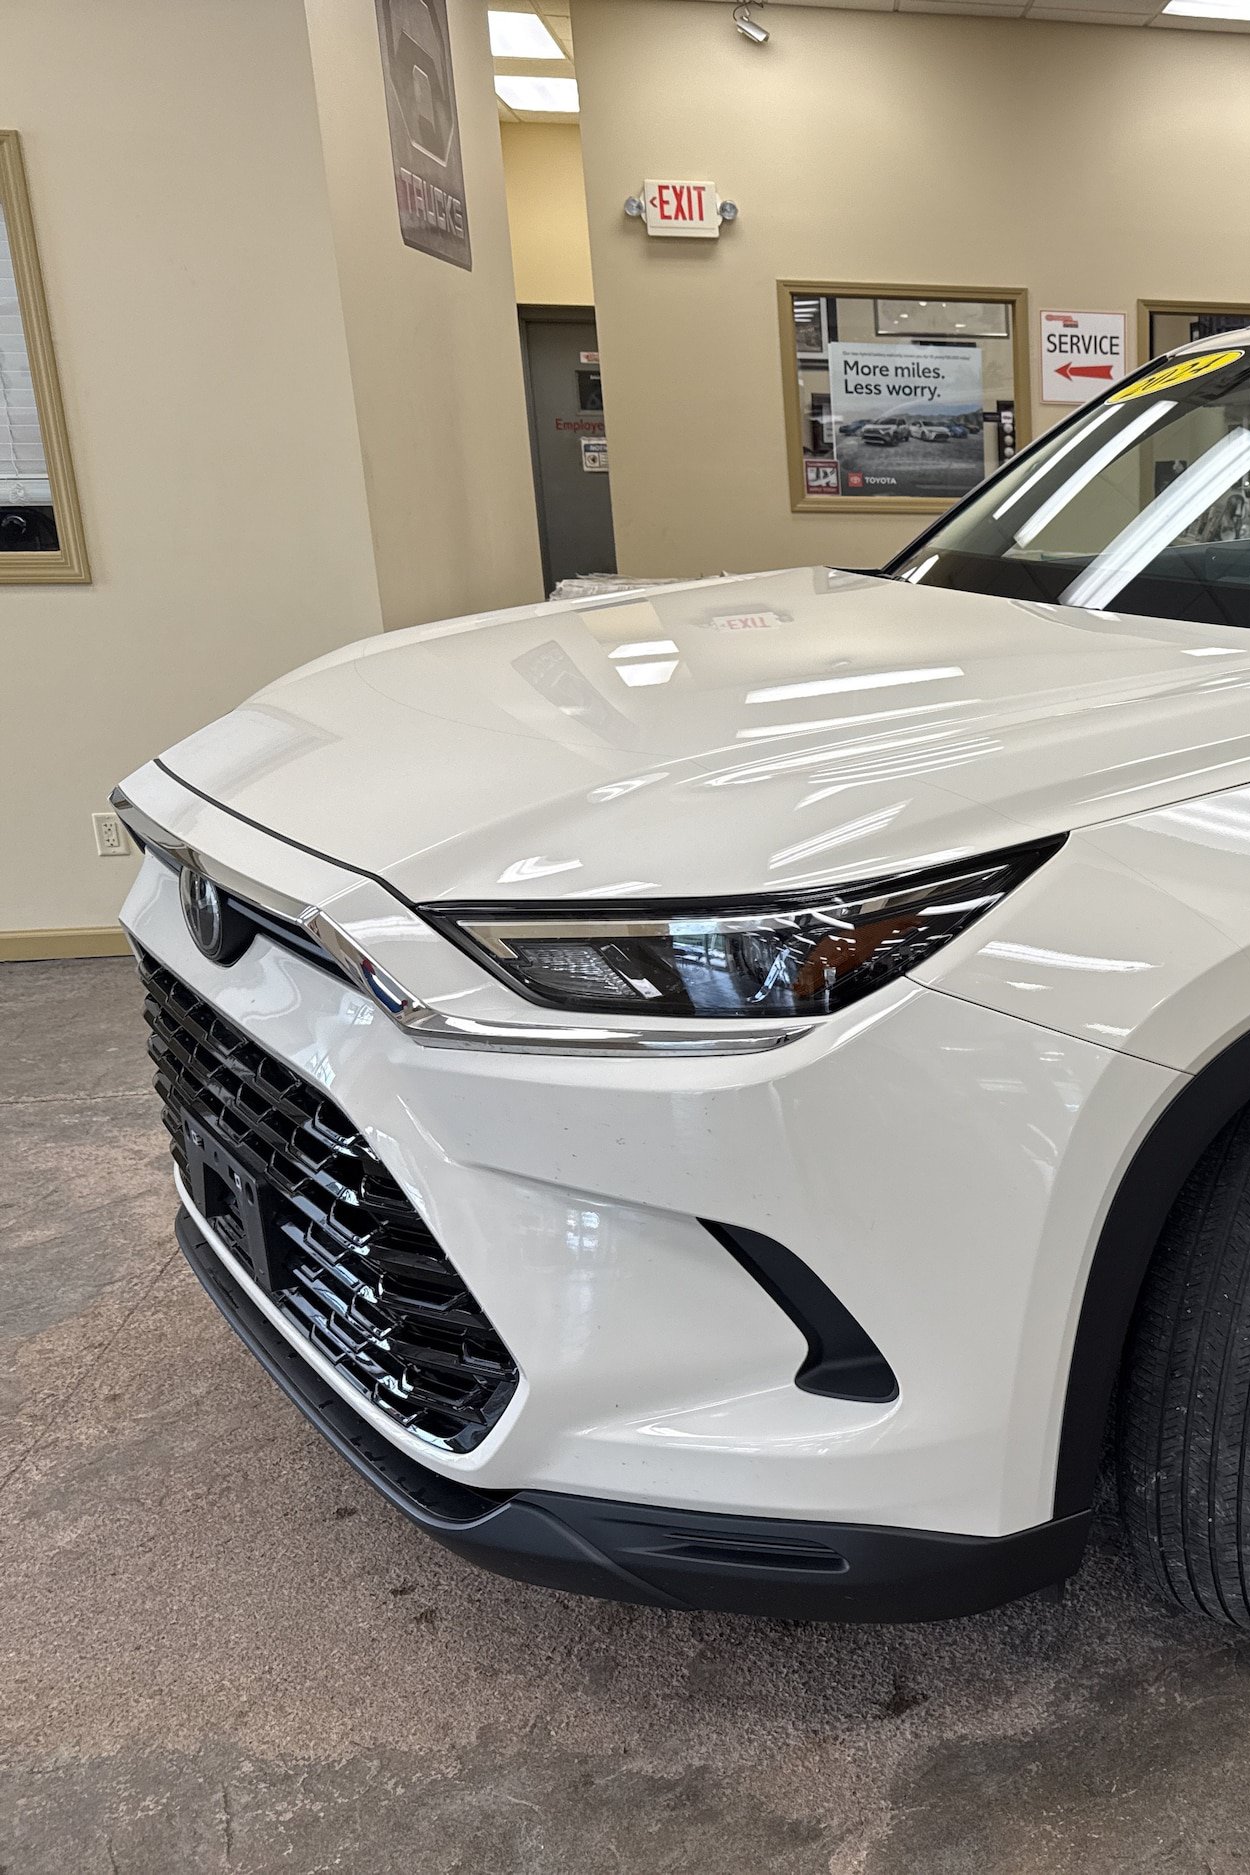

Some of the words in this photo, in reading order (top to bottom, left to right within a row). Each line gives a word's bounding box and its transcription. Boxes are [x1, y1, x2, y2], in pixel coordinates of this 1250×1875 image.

[400, 167, 465, 239] TRUCKS
[658, 185, 706, 221] EXIT
[1046, 333, 1120, 355] SERVICE
[843, 360, 890, 377] More
[894, 362, 946, 379] miles.
[844, 379, 882, 395] Less
[886, 385, 942, 401] worry.
[864, 476, 897, 485] TOYOTA
